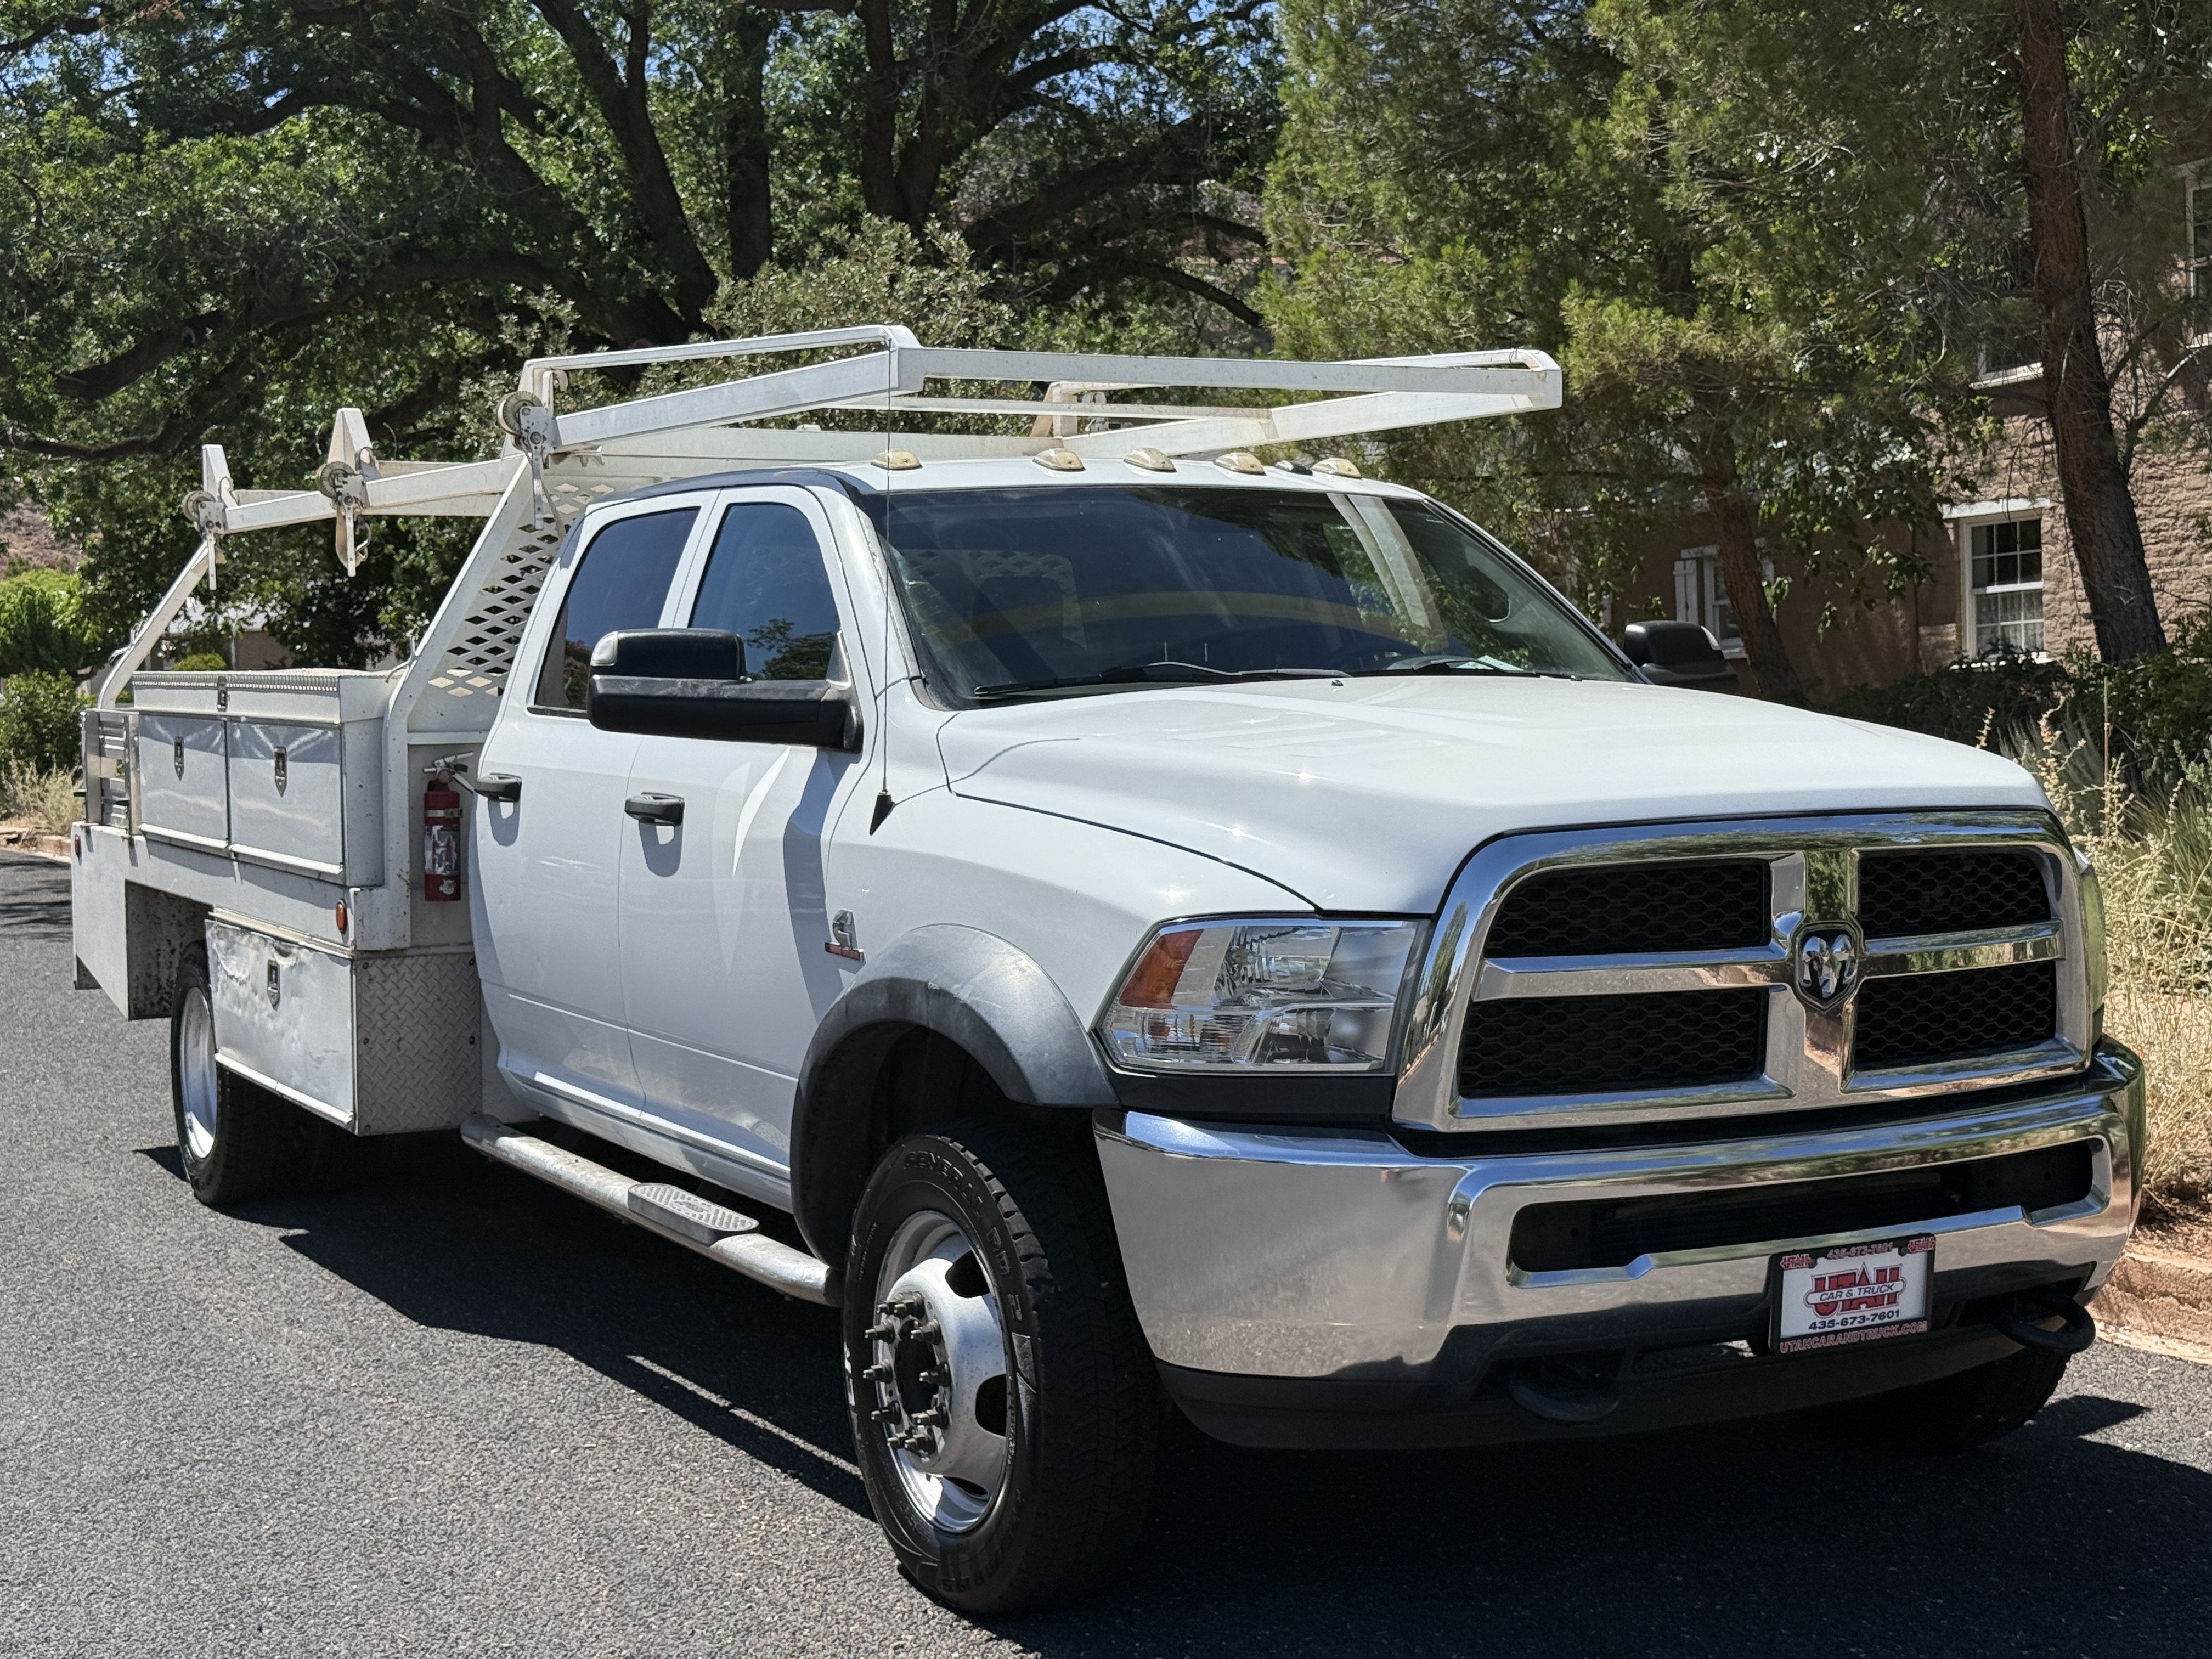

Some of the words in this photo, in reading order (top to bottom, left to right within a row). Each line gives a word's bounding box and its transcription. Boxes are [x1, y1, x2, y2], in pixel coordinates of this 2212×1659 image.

[904, 1150, 984, 1218] GENERAL
[1827, 1242, 1893, 1259] 435-673-7601
[1813, 1263, 1901, 1317] UTAH
[1820, 1291, 1843, 1301] CAR
[1845, 1289, 1853, 1297] &
[1857, 1283, 1895, 1296] TRUCK
[1808, 1309, 1900, 1330] 435-673-7601
[1779, 1320, 1928, 1354] UTAHCARANDTRUCK.COM
